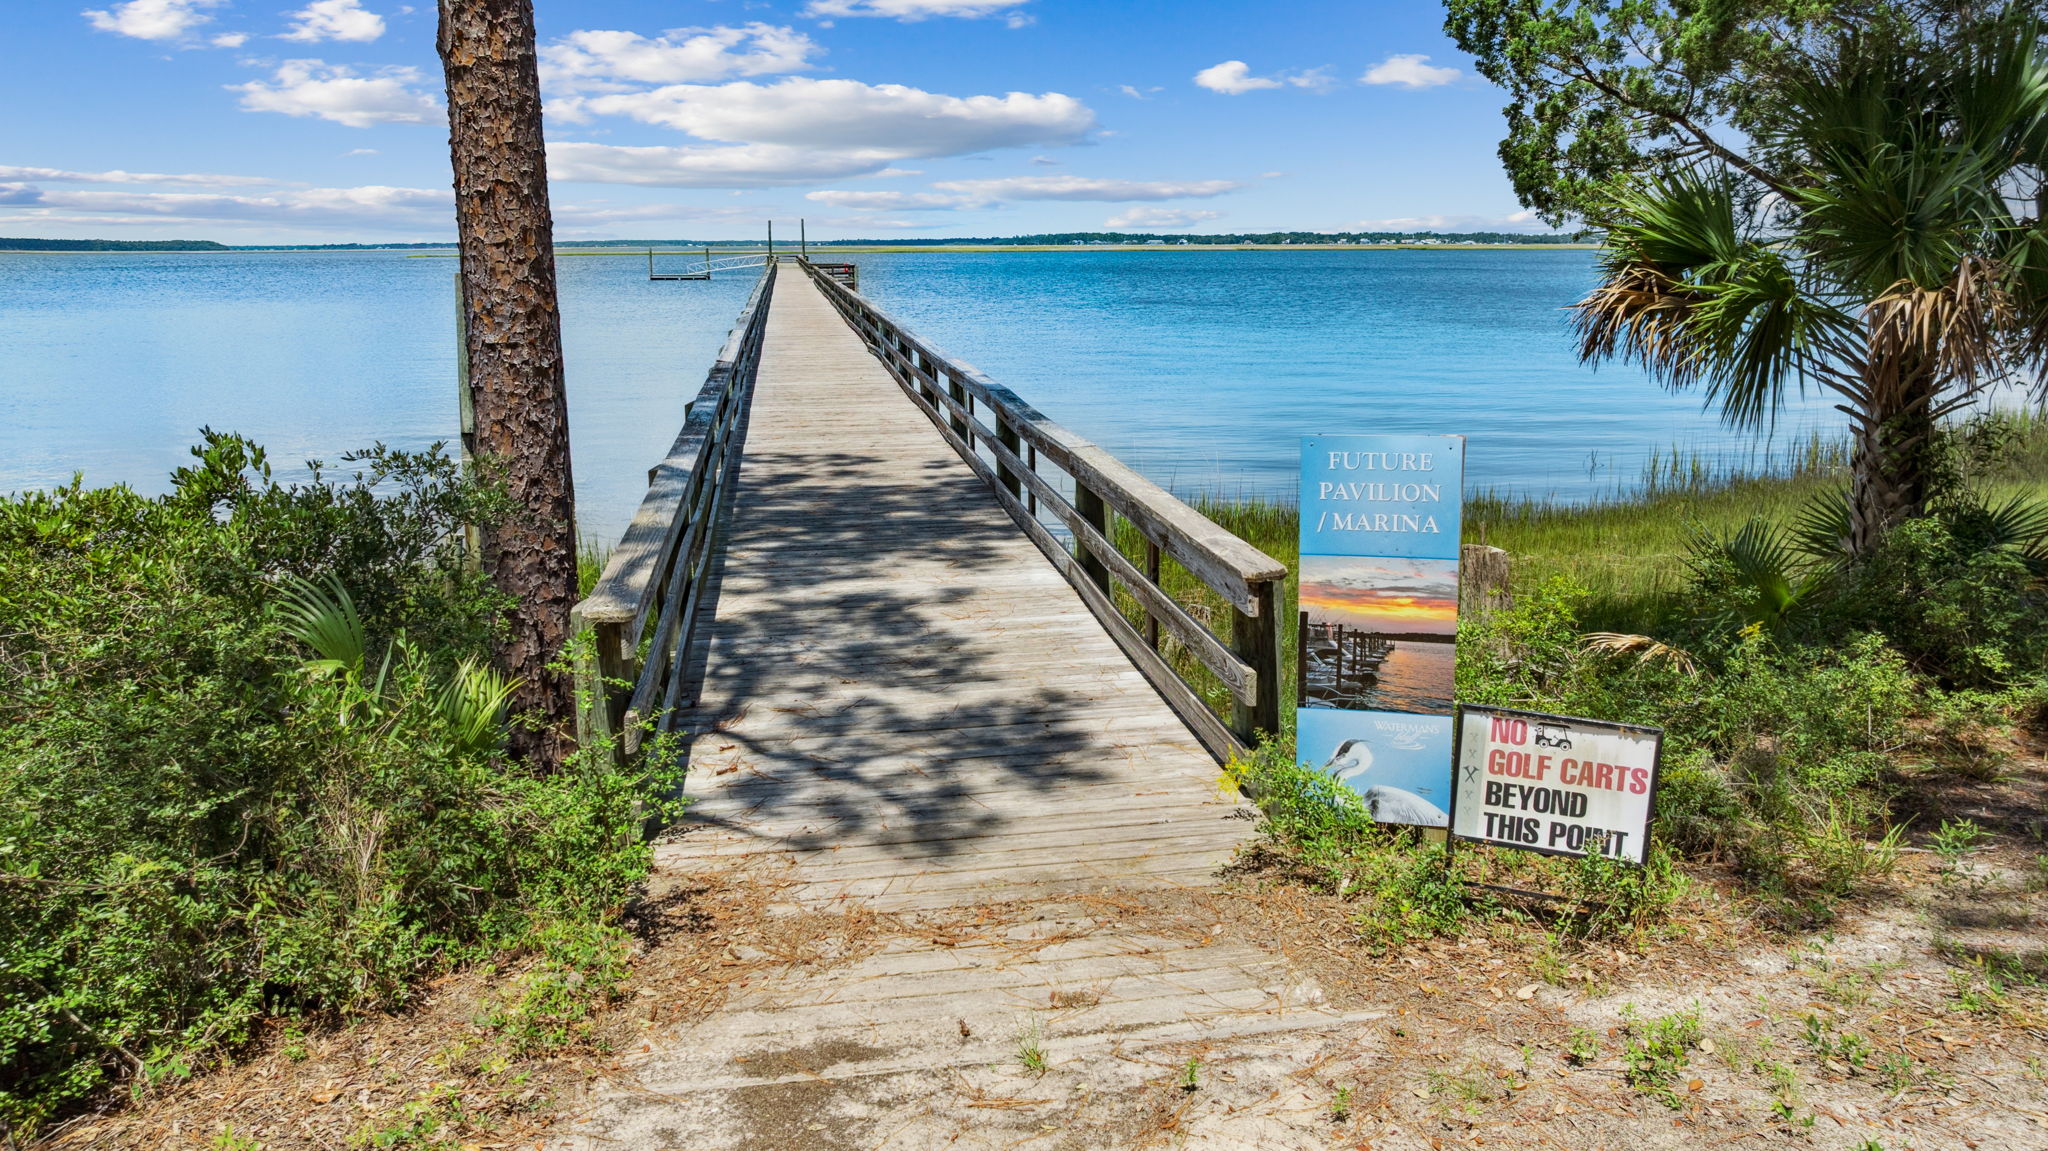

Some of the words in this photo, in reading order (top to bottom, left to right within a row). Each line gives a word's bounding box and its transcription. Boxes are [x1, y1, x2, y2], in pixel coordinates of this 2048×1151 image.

[1328, 451, 1433, 472] FUTURE
[1319, 481, 1441, 503] PAVILION
[1490, 717, 1528, 746] NO
[1488, 749, 1552, 781] GOLF
[1559, 758, 1649, 795] CARTS
[1484, 780, 1588, 818] BEYOND
[1483, 812, 1540, 844] THIS
